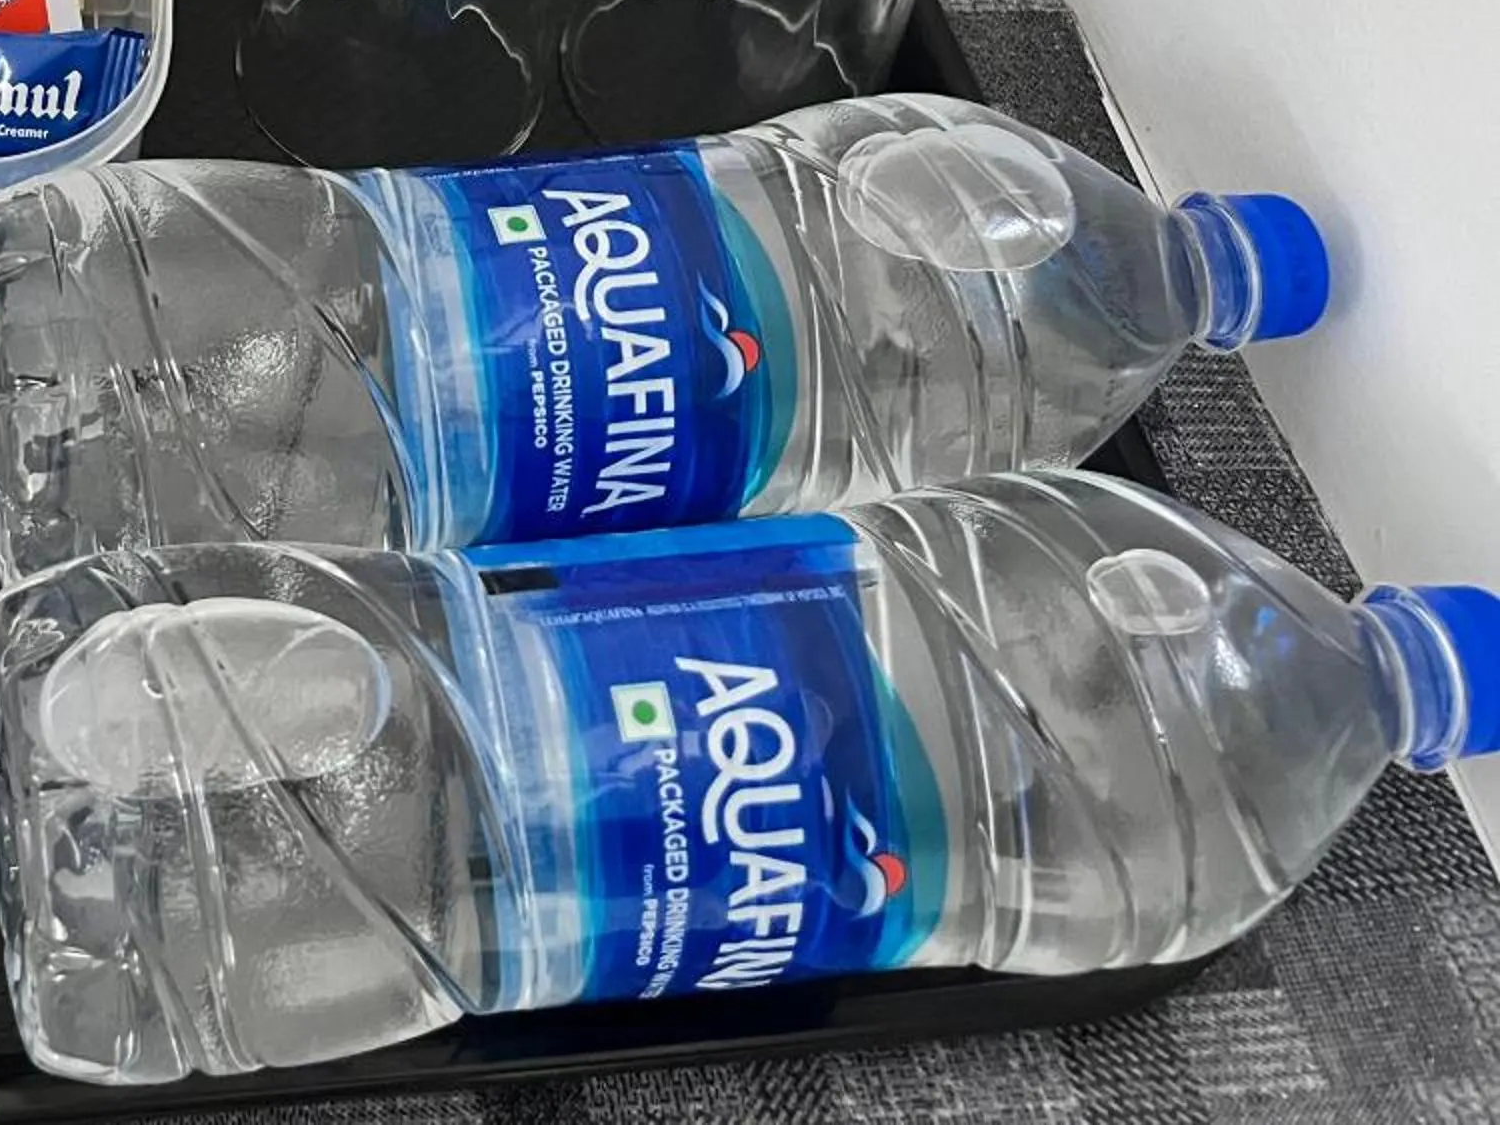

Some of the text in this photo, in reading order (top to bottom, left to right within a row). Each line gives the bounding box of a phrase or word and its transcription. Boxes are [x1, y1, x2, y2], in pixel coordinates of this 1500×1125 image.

[527, 338, 547, 448] from PEPSICO
[528, 246, 574, 513] PACKAGED DRINKING WATER
[542, 188, 676, 518] AQUAFINA
[653, 748, 688, 881] PACKAGED
[635, 863, 659, 966] from PEPSICO
[656, 887, 690, 971] DRINKING
